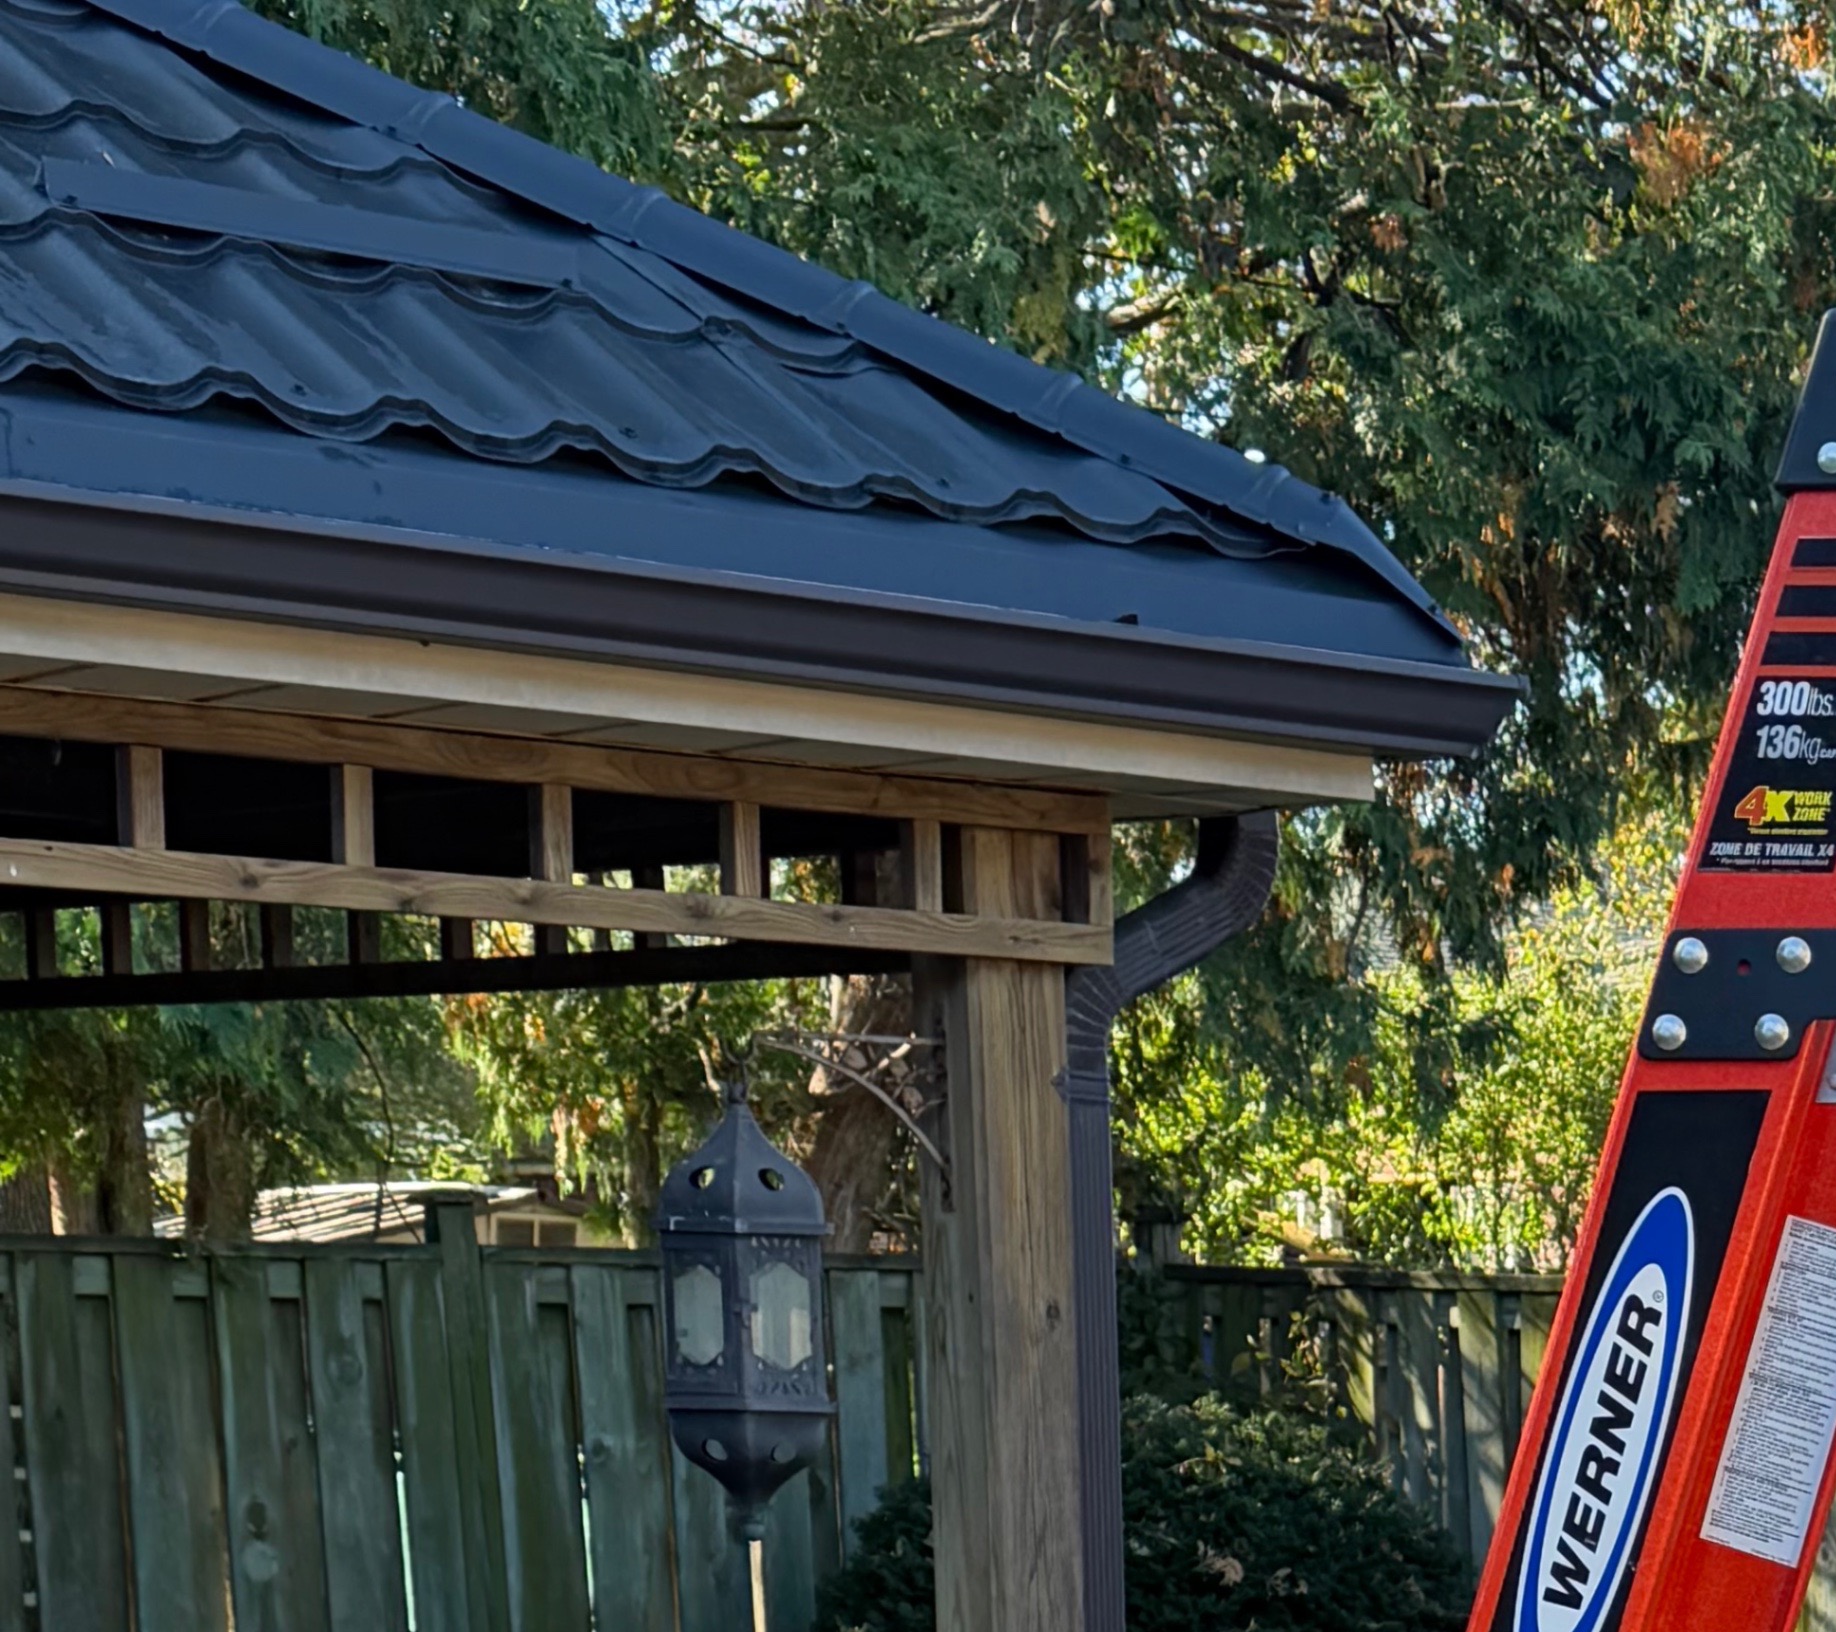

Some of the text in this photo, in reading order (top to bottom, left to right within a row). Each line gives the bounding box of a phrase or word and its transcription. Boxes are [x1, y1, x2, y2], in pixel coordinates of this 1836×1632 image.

[1734, 785, 1793, 826] 4X
[1793, 790, 1833, 806] WORK
[1709, 842, 1835, 857] ZONE DE TRAVAIL X4
[1542, 1294, 1662, 1610] WERNER
